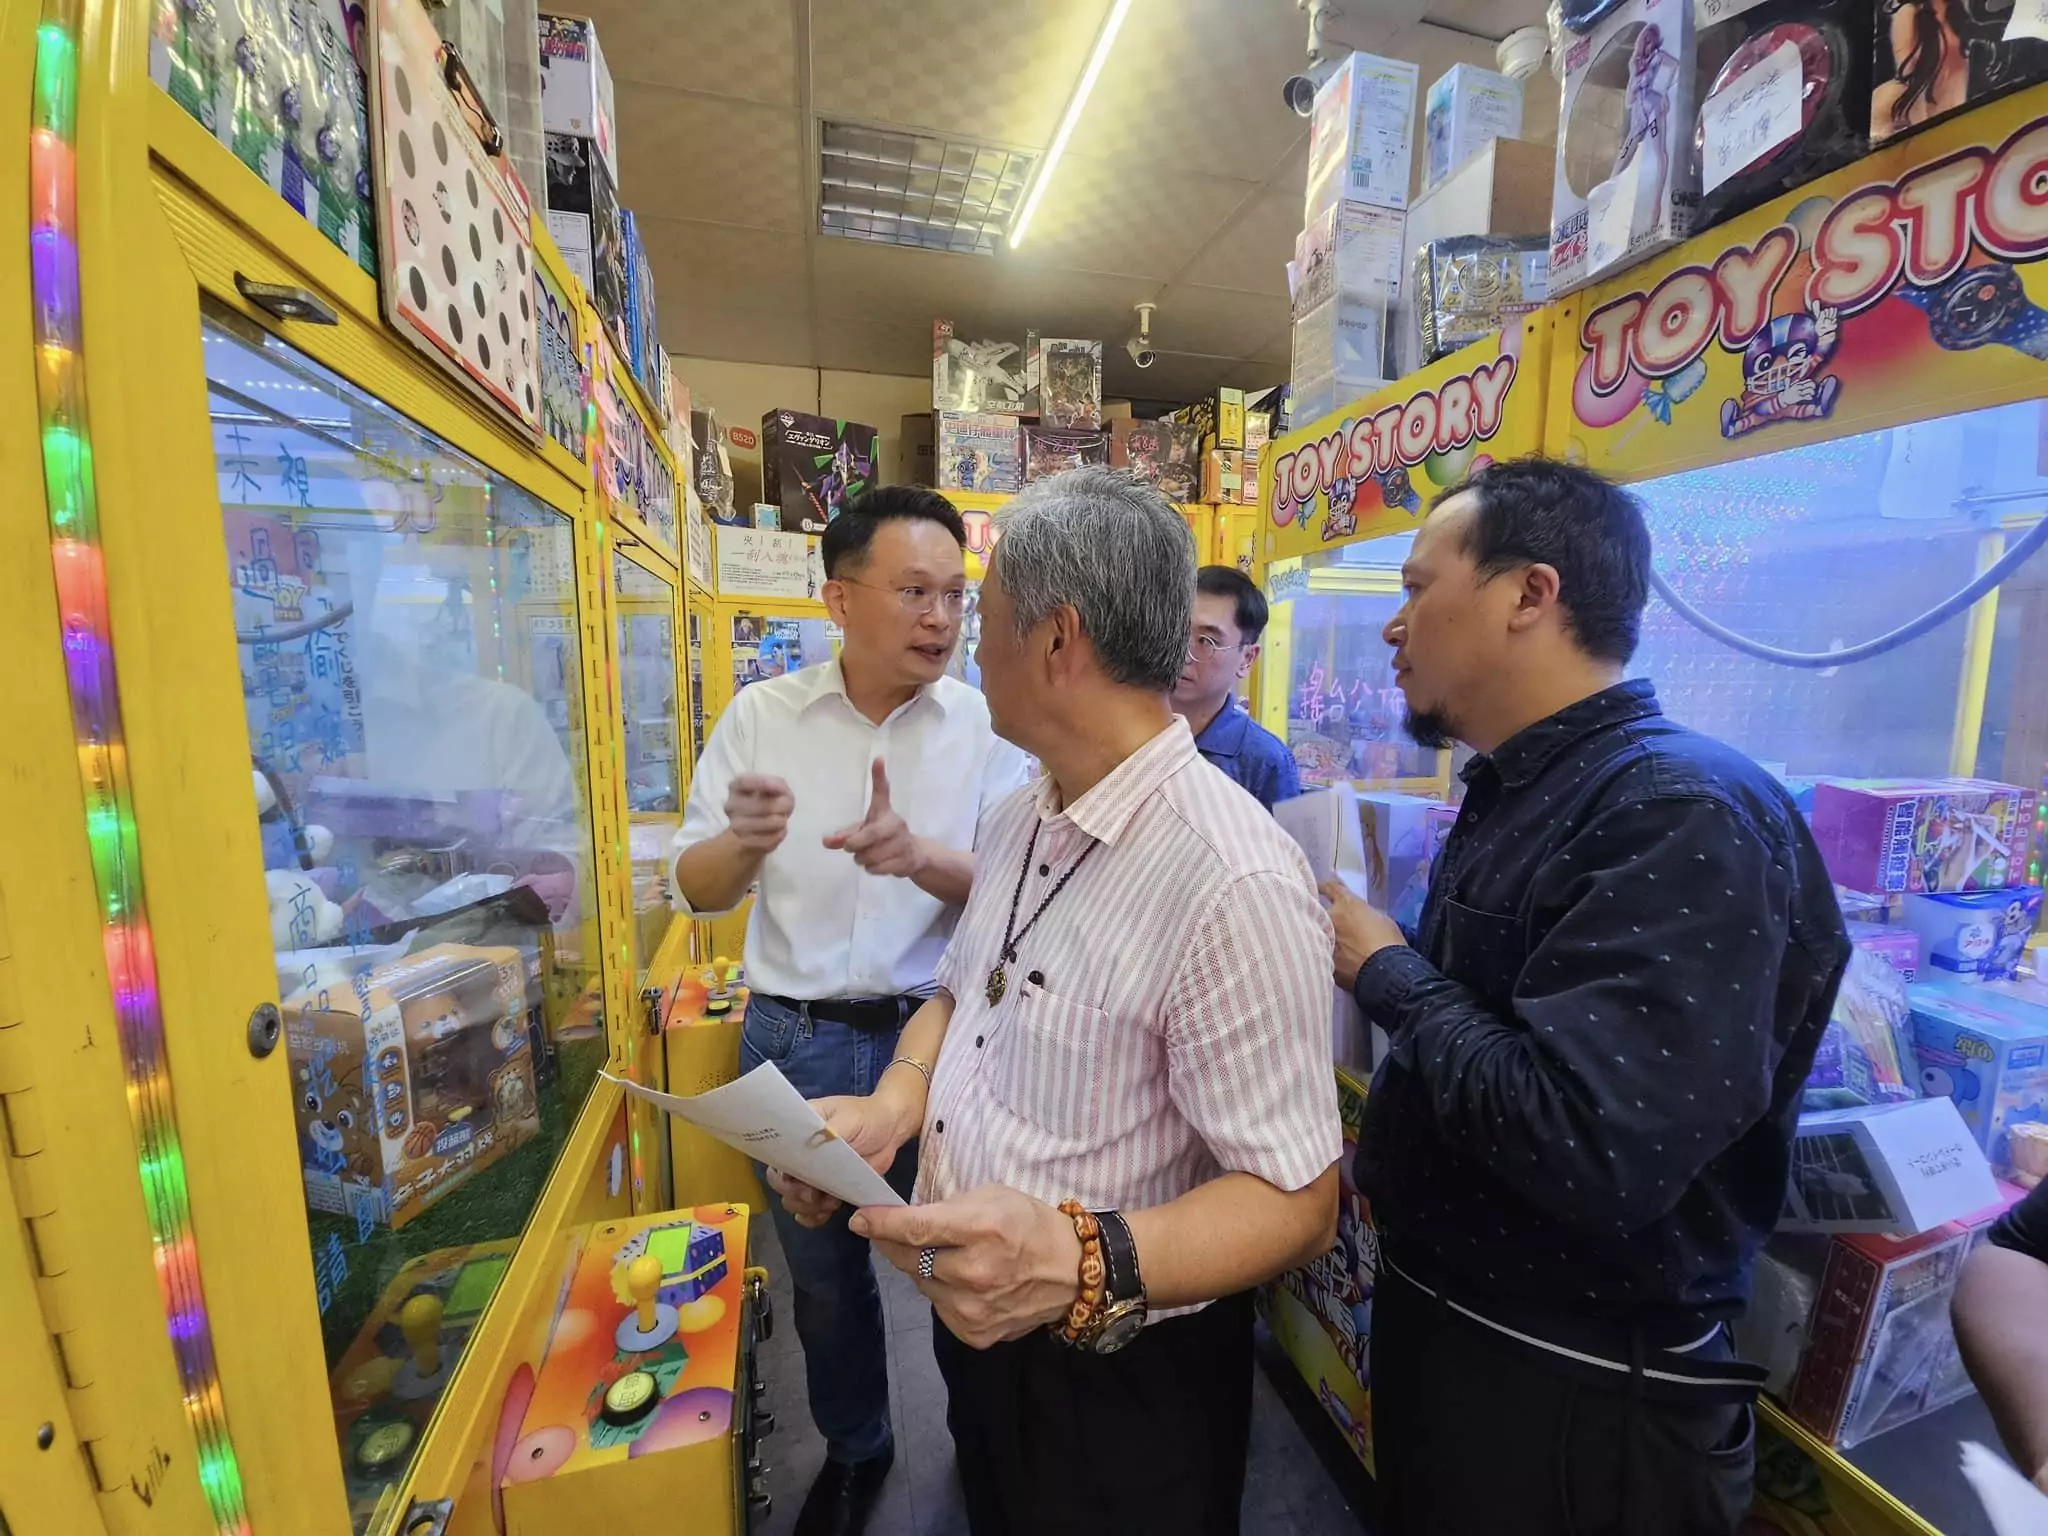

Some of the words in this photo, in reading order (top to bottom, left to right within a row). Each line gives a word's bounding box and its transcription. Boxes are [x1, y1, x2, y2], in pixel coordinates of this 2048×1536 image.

[1579, 223, 1802, 397] TOY
[732, 432, 755, 446] B520
[1272, 431, 1343, 510] TOY
[1347, 353, 1519, 484] STORY
